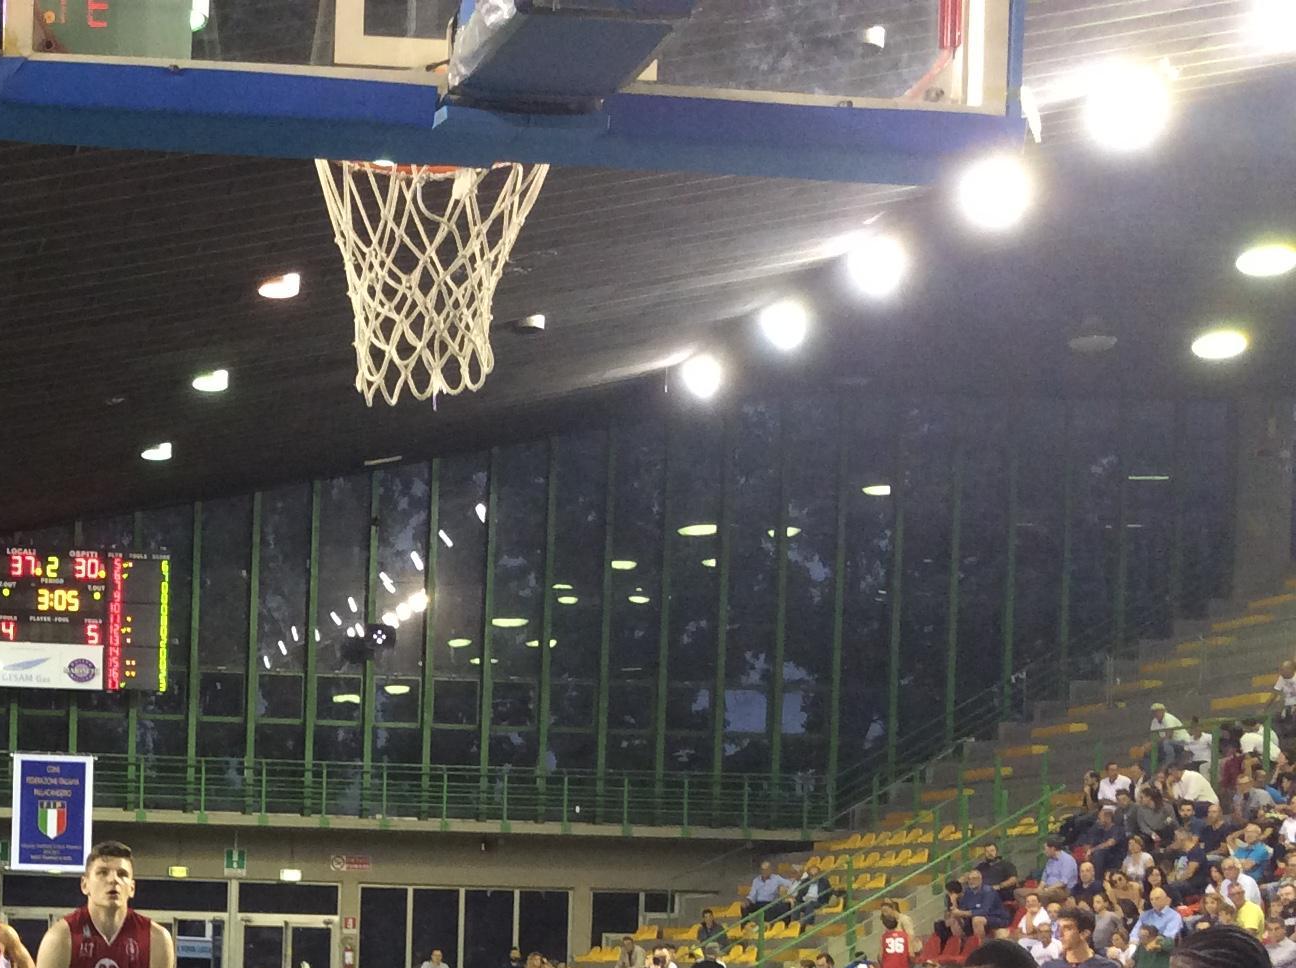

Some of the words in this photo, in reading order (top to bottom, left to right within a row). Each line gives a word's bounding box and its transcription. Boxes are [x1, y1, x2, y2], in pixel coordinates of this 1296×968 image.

[7, 548, 36, 556] LOCALI
[69, 550, 98, 558] OSPITI
[11, 555, 36, 576] 37
[46, 556, 59, 578] 2
[75, 558, 99, 579] 30
[37, 589, 80, 612] 3:05
[1, 622, 14, 641] 4
[87, 624, 99, 645] 5
[885, 937, 905, 954] 36
